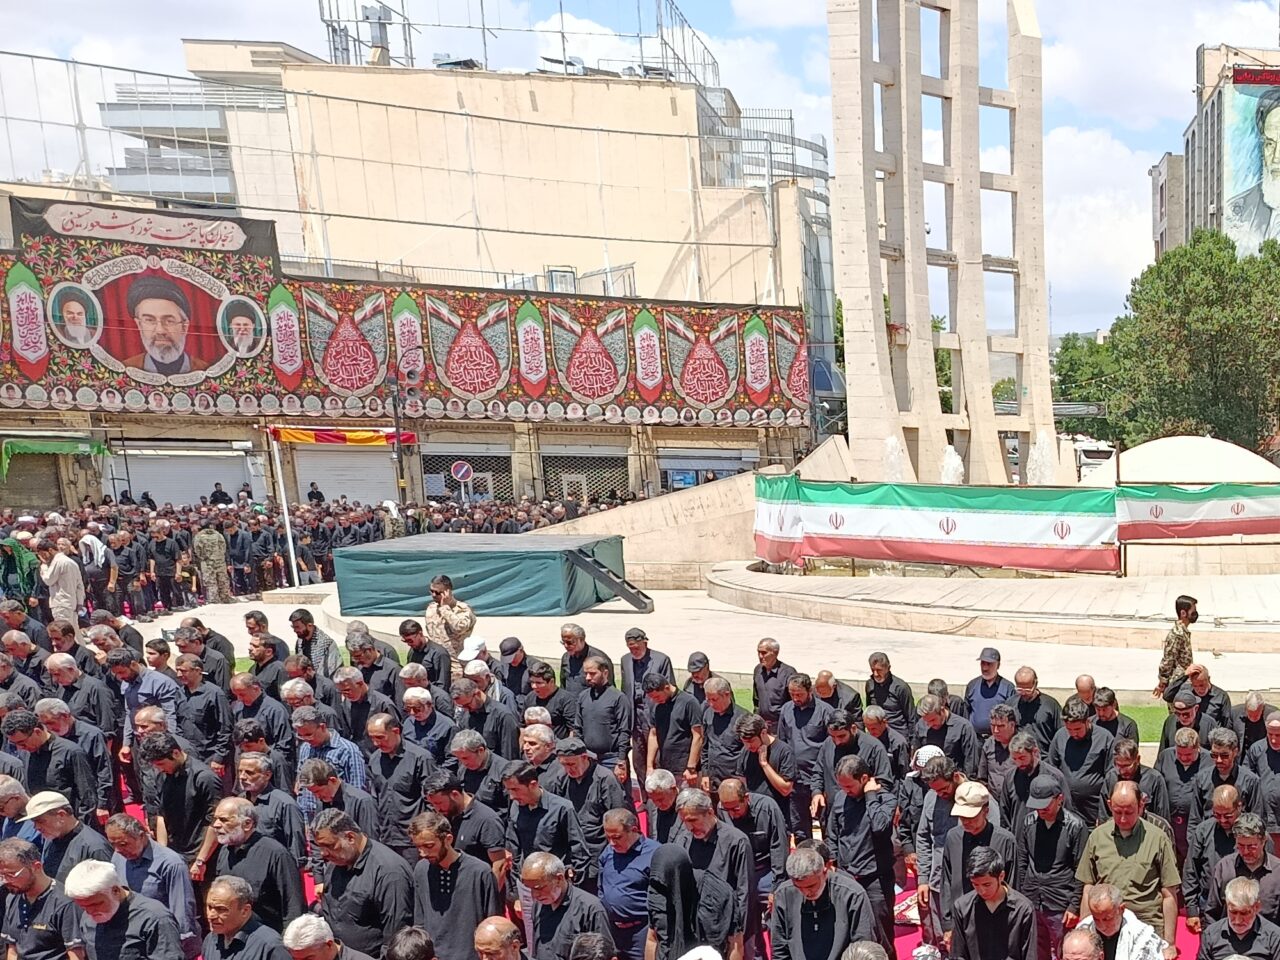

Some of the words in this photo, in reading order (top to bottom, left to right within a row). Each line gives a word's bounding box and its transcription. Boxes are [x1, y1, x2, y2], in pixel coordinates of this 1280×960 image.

[62, 208, 92, 232] حسینی
[84, 212, 142, 231] شعور
[130, 225, 135, 234] و
[137, 218, 153, 235] شور
[150, 221, 205, 247] پایتخت
[205, 226, 235, 248] زنجان
